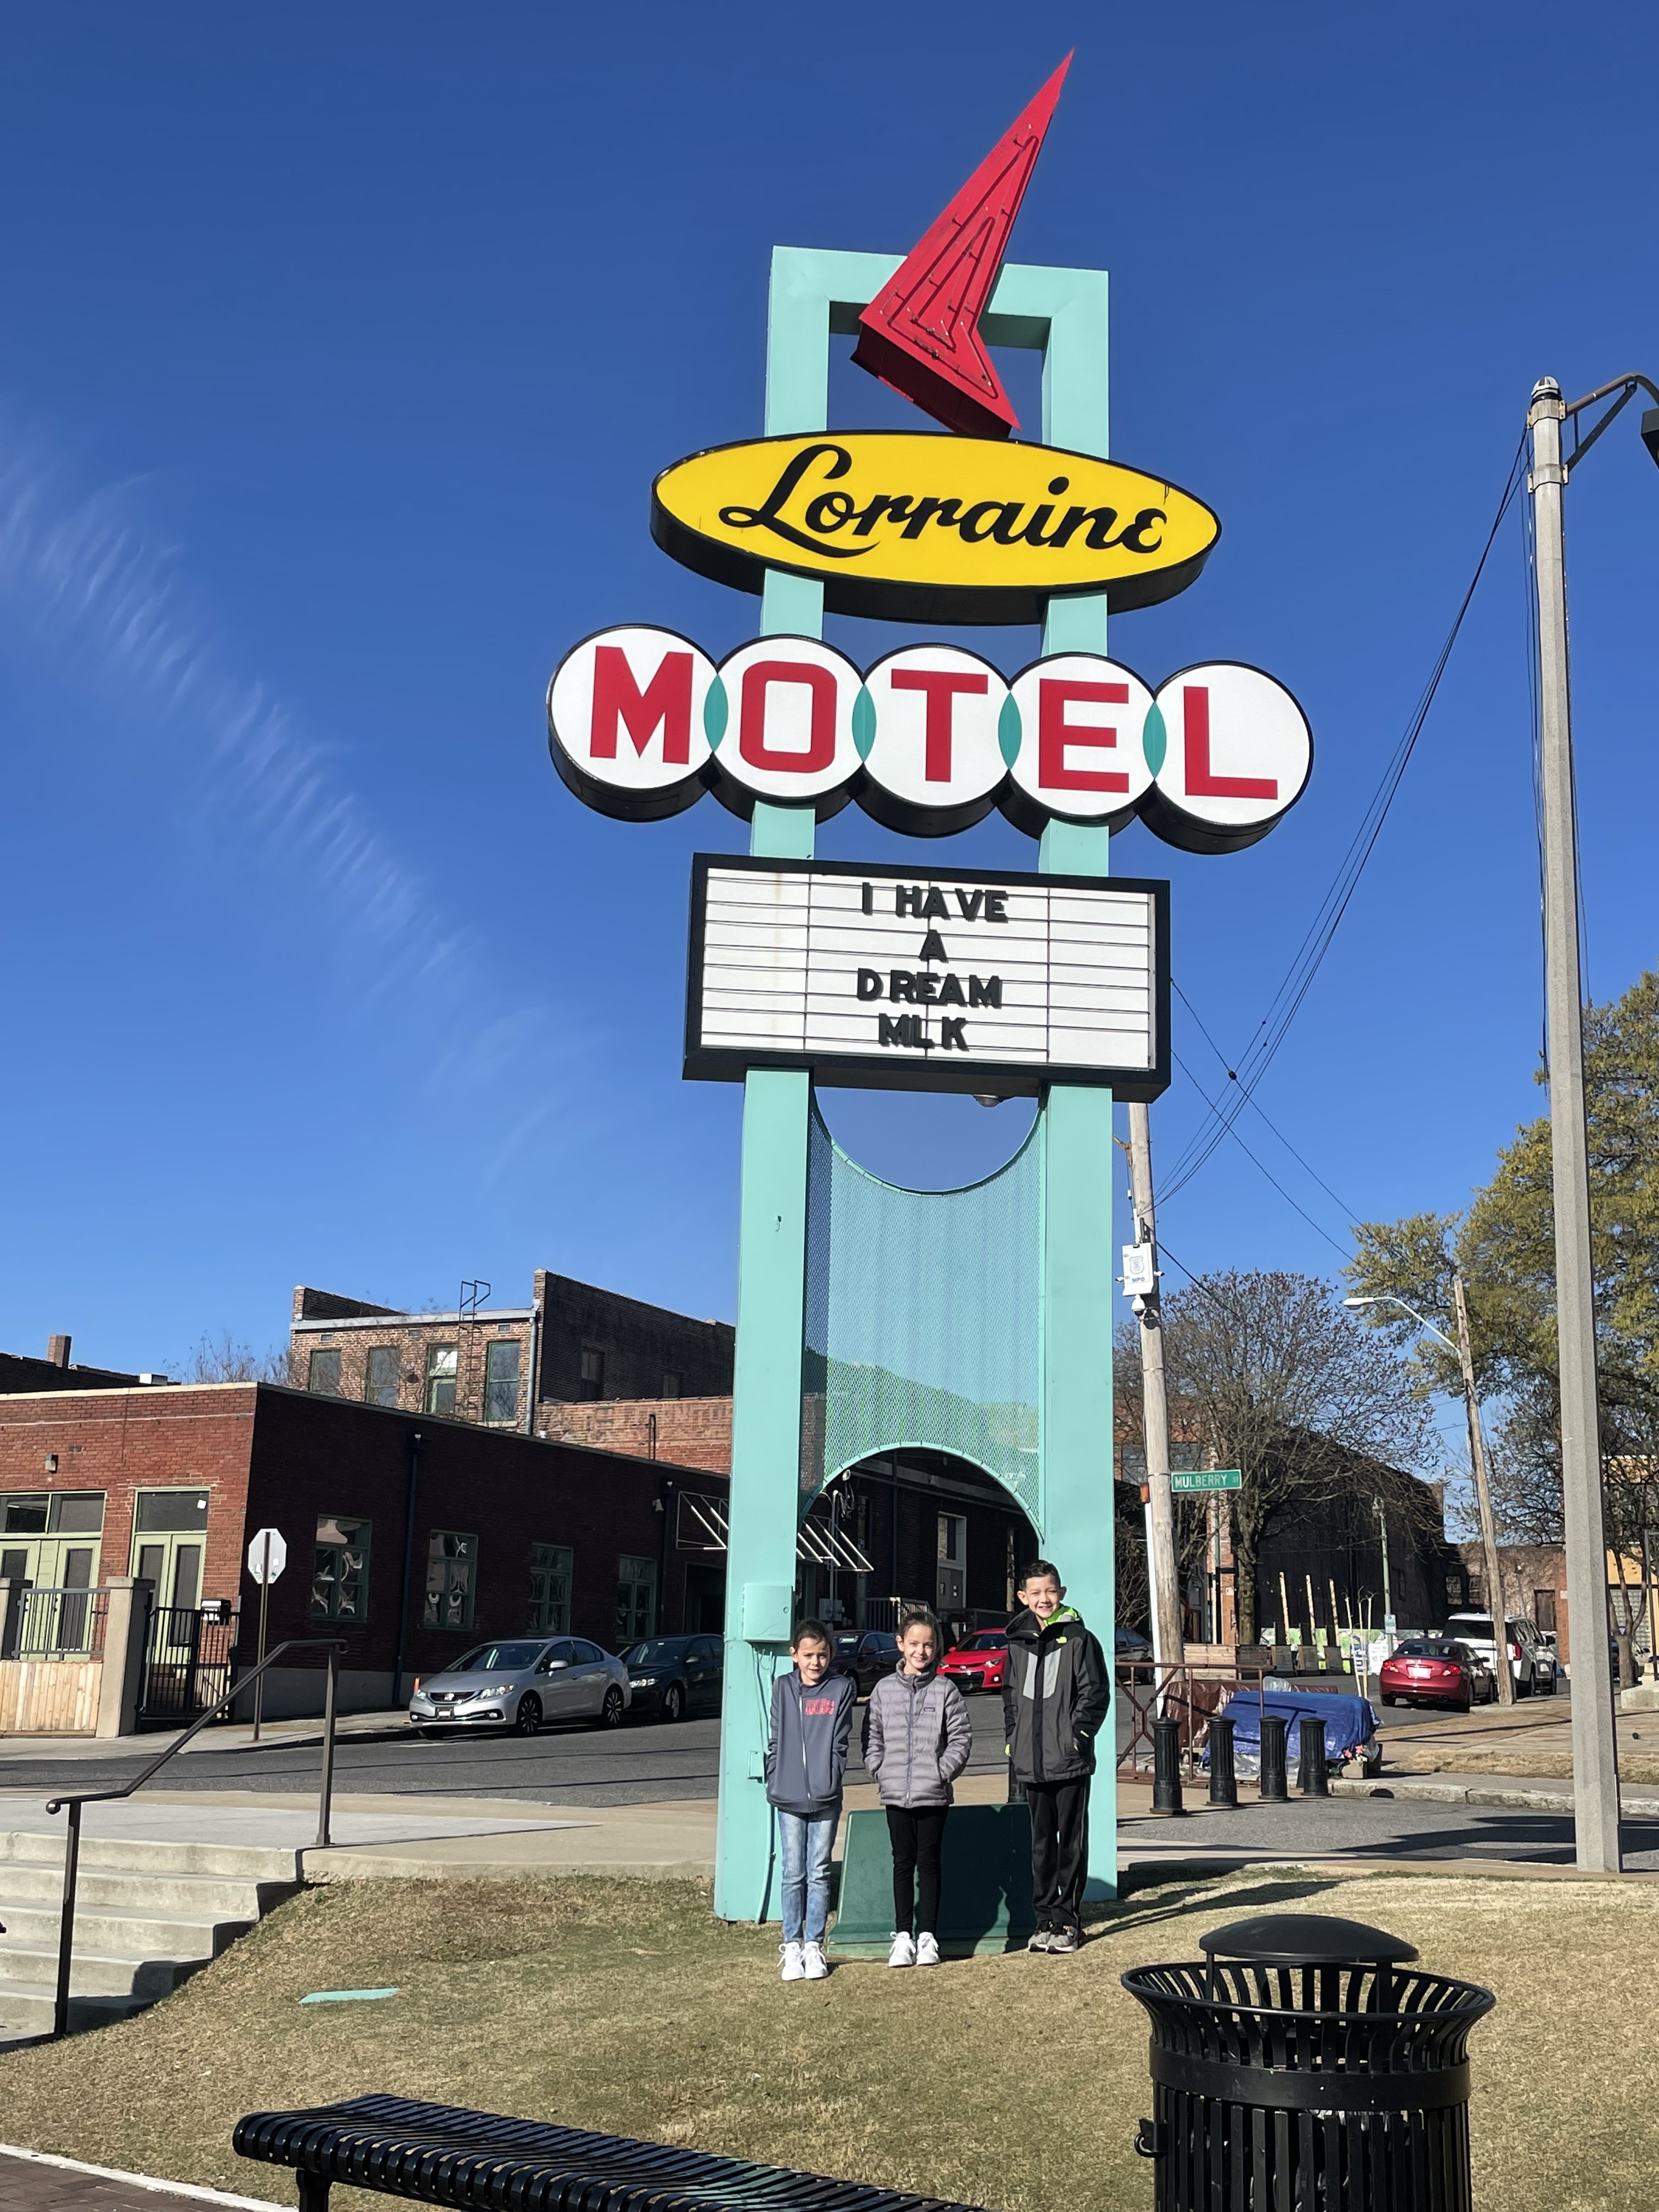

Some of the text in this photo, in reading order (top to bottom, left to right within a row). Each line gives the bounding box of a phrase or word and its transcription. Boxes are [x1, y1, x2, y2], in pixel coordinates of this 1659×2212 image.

[719, 444, 1167, 558] Lorraine
[590, 646, 1278, 799] MOTEL
[862, 882, 1008, 923] I HAVE
[918, 929, 949, 963] A
[857, 968, 1002, 1009] DREAM
[878, 1013, 969, 1051] MLK
[1175, 1474, 1227, 1488] MULBERRY
